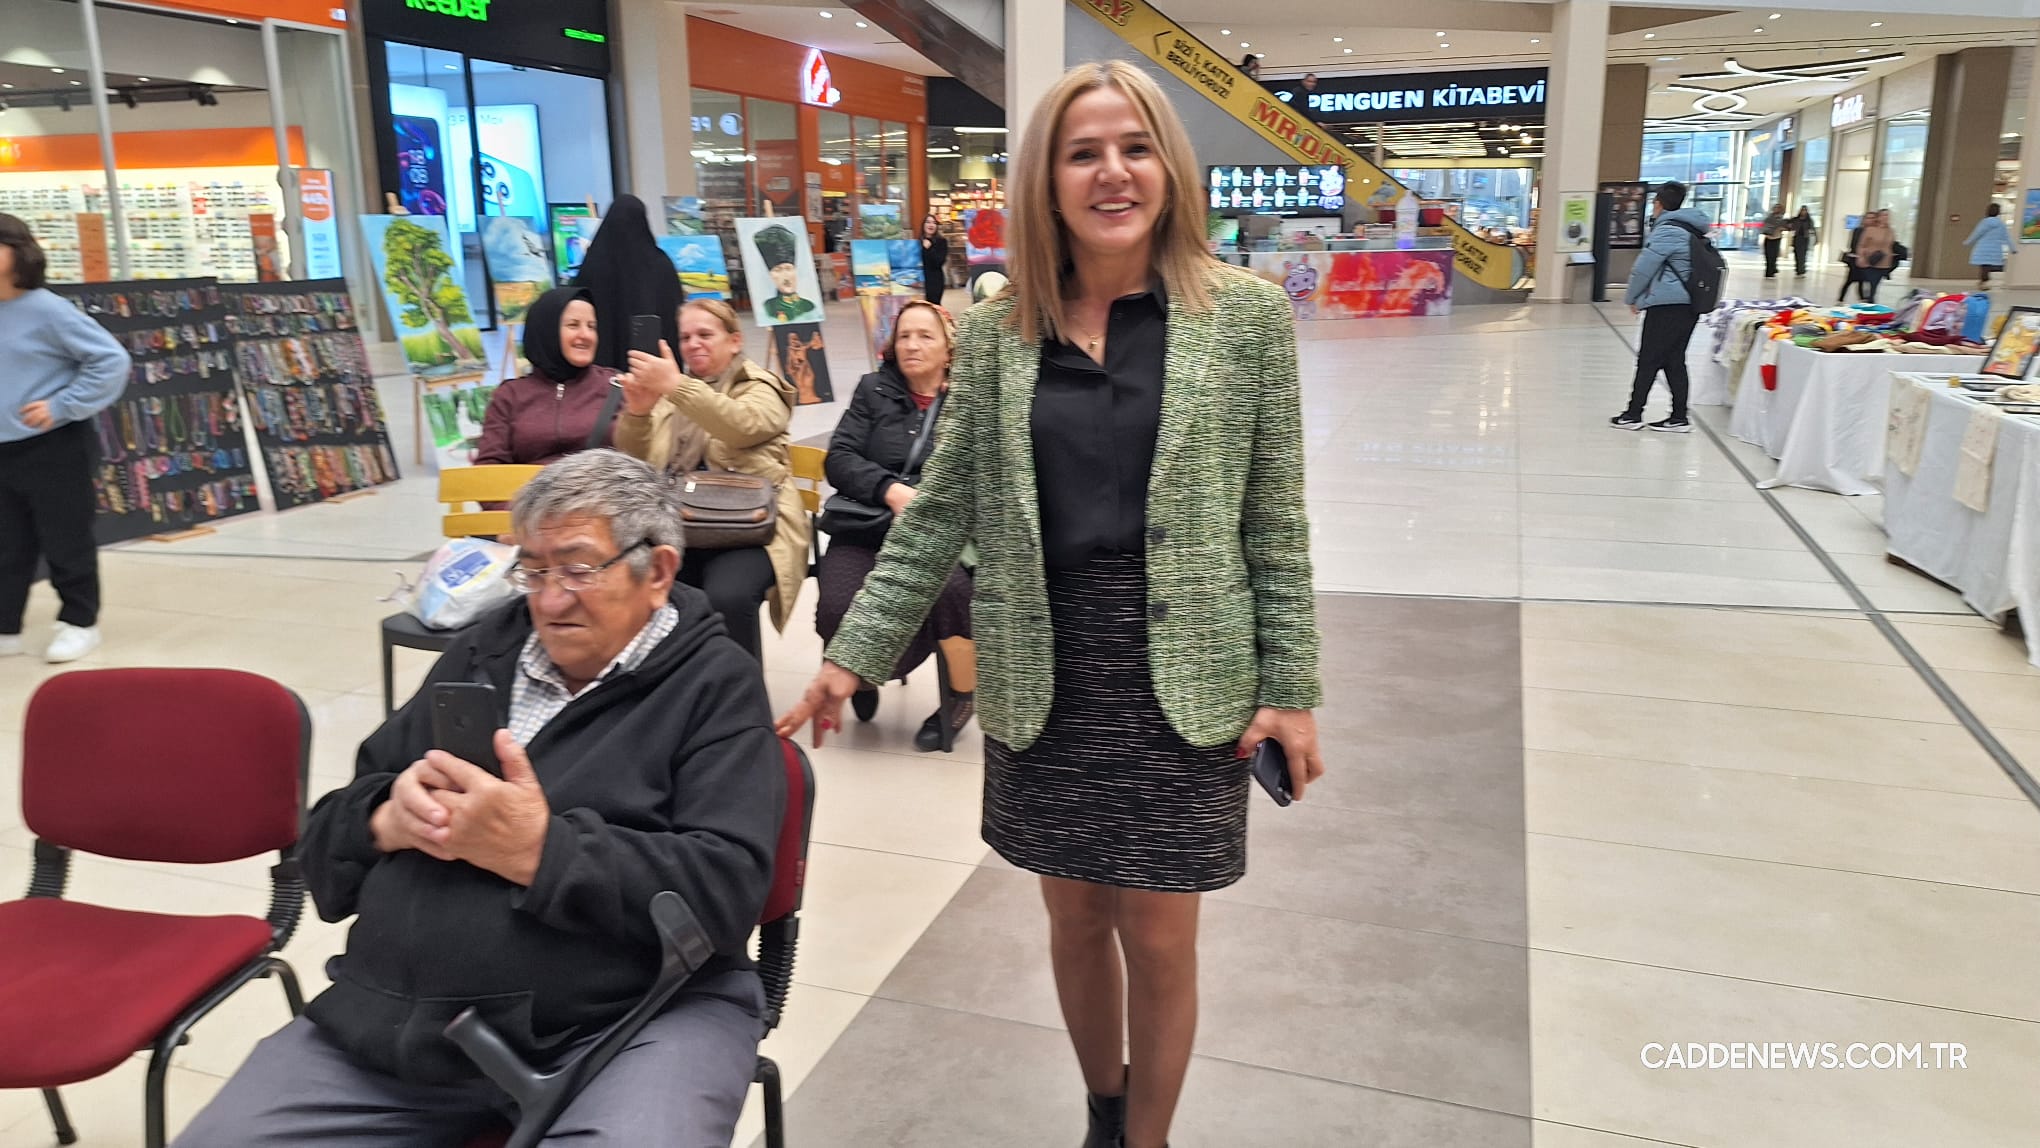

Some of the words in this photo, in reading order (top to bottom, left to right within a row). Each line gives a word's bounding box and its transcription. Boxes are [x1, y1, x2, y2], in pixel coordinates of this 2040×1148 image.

[1203, 60, 1235, 87] KATTA
[1308, 89, 1425, 113] PENGUEN
[1432, 80, 1546, 107] KİTABEVİ
